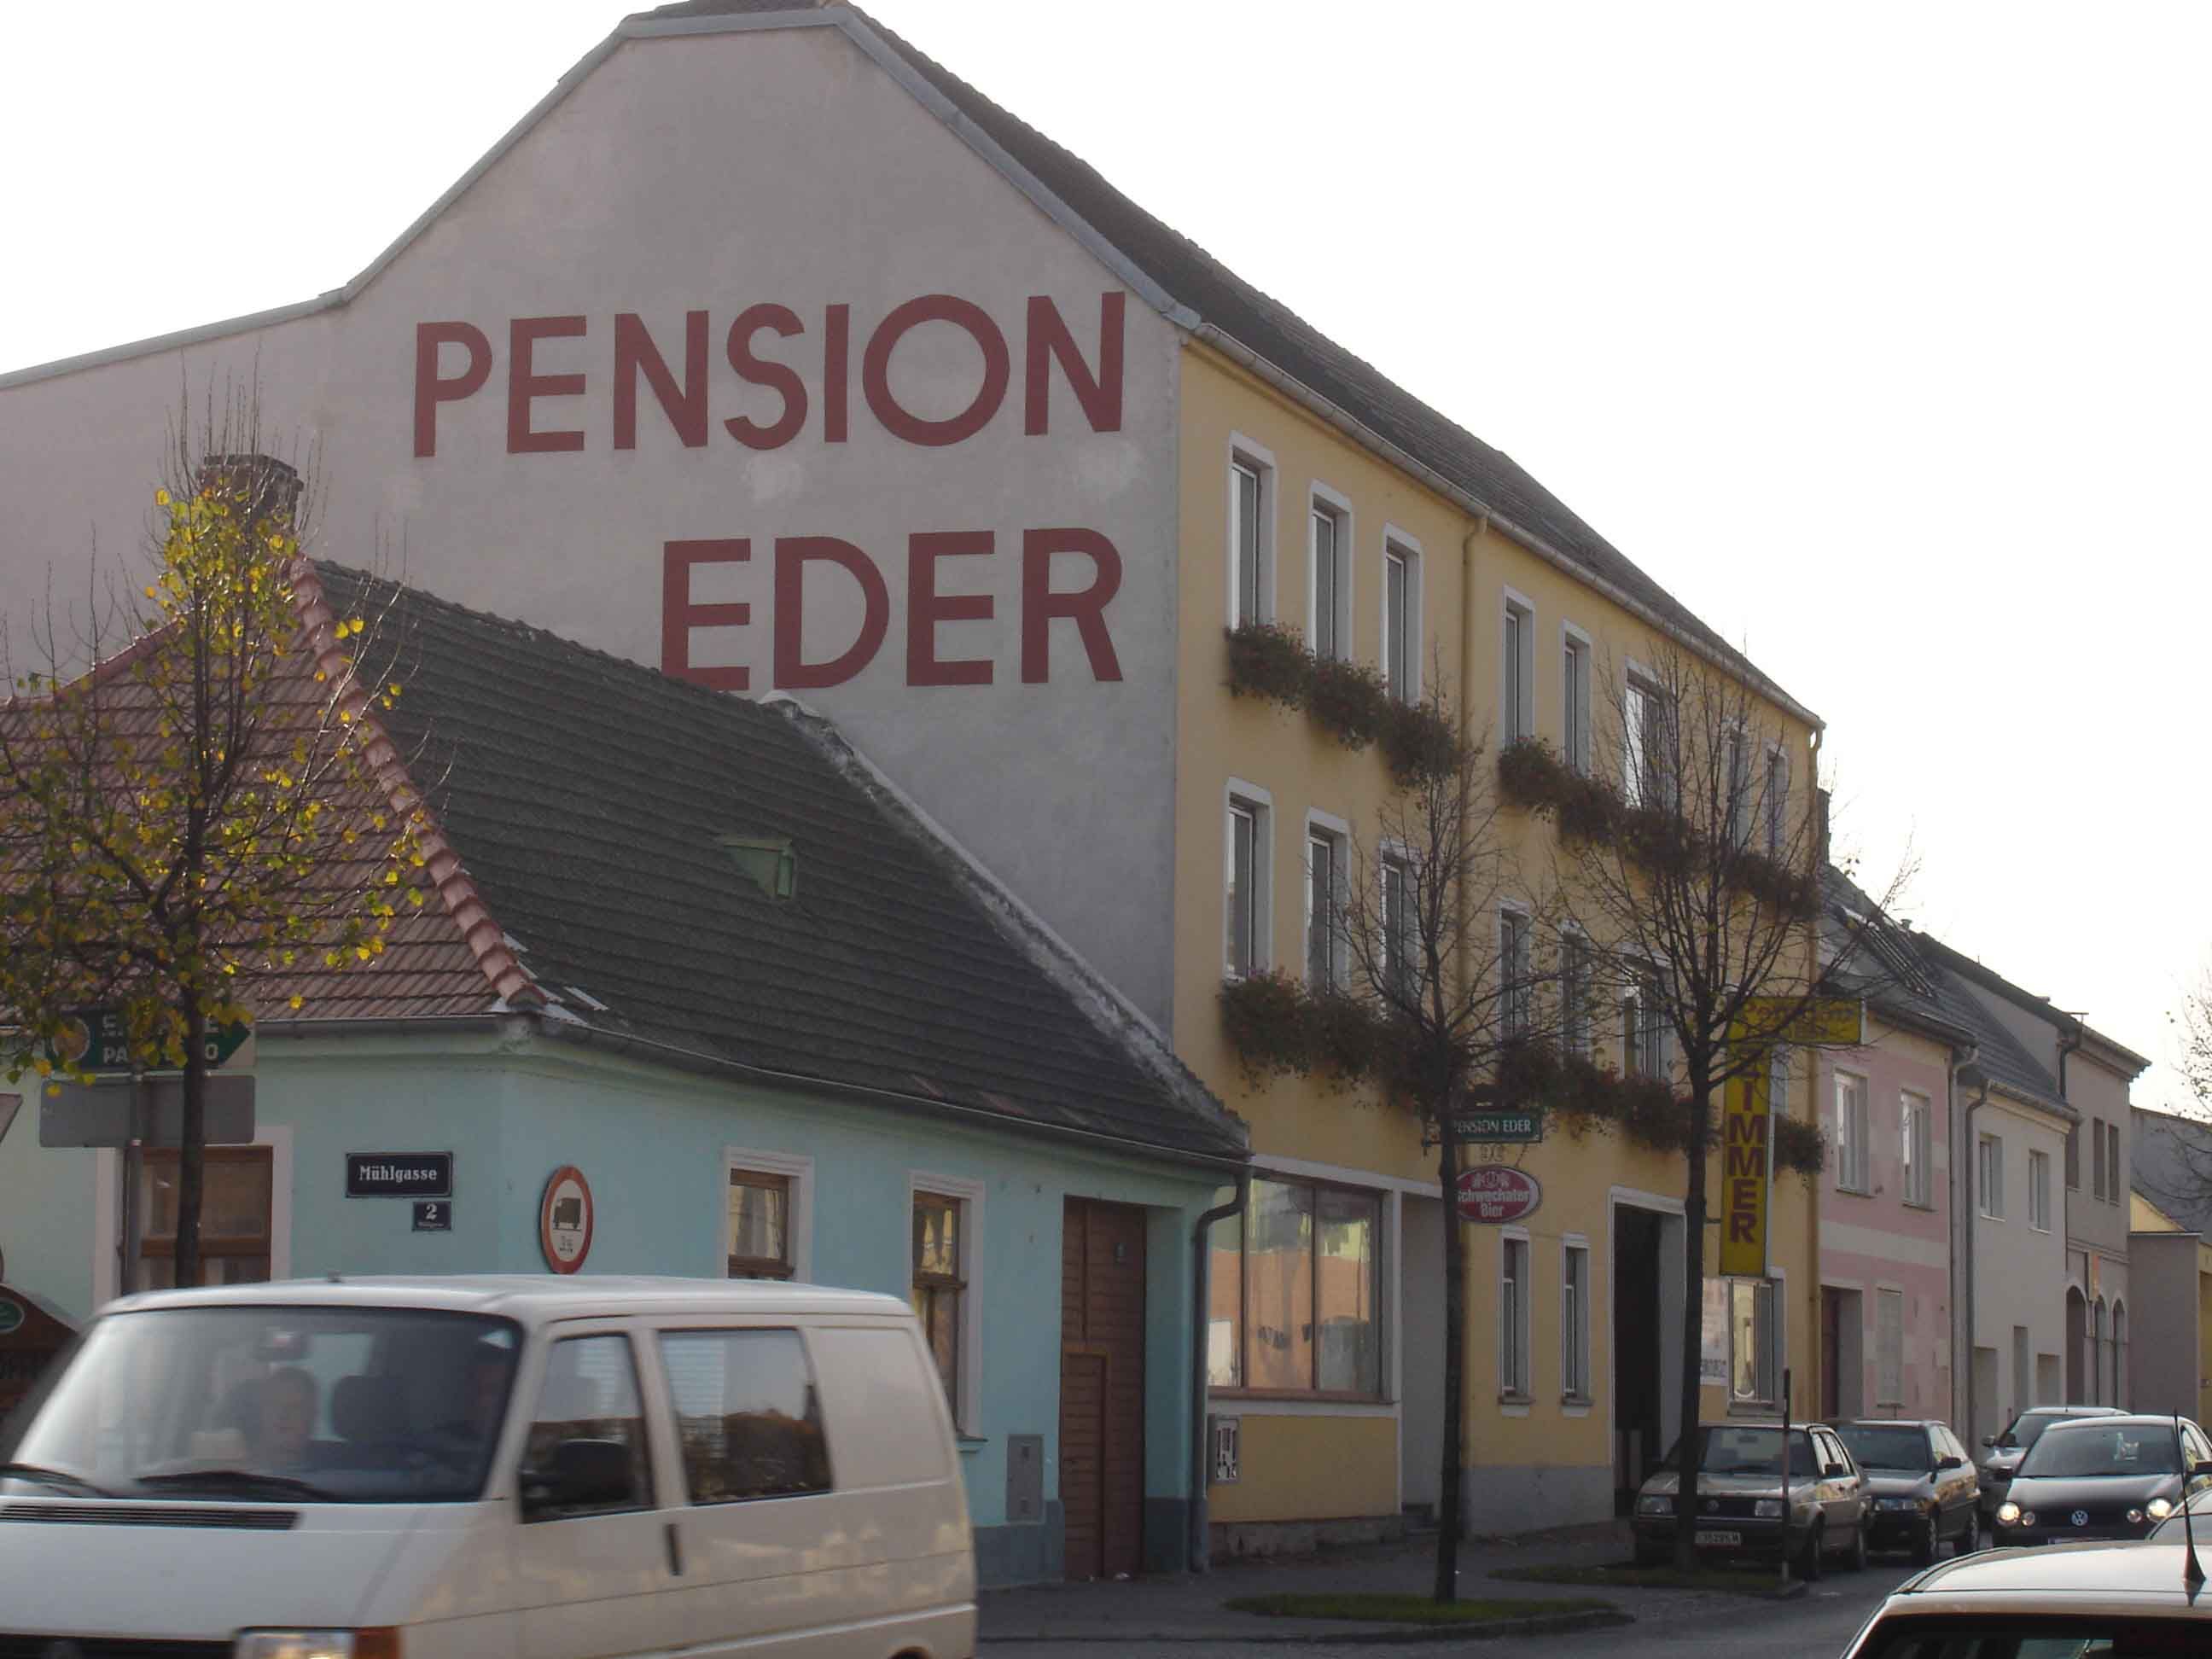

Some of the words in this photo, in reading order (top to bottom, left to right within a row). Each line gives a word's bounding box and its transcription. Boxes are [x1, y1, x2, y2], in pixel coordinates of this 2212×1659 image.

[414, 292, 1126, 458] PENSION
[661, 527, 1124, 691] EDER
[1502, 1119, 1532, 1132] EDER
[358, 1164, 438, 1183] Mühlgasse
[426, 1203, 438, 1220] 2
